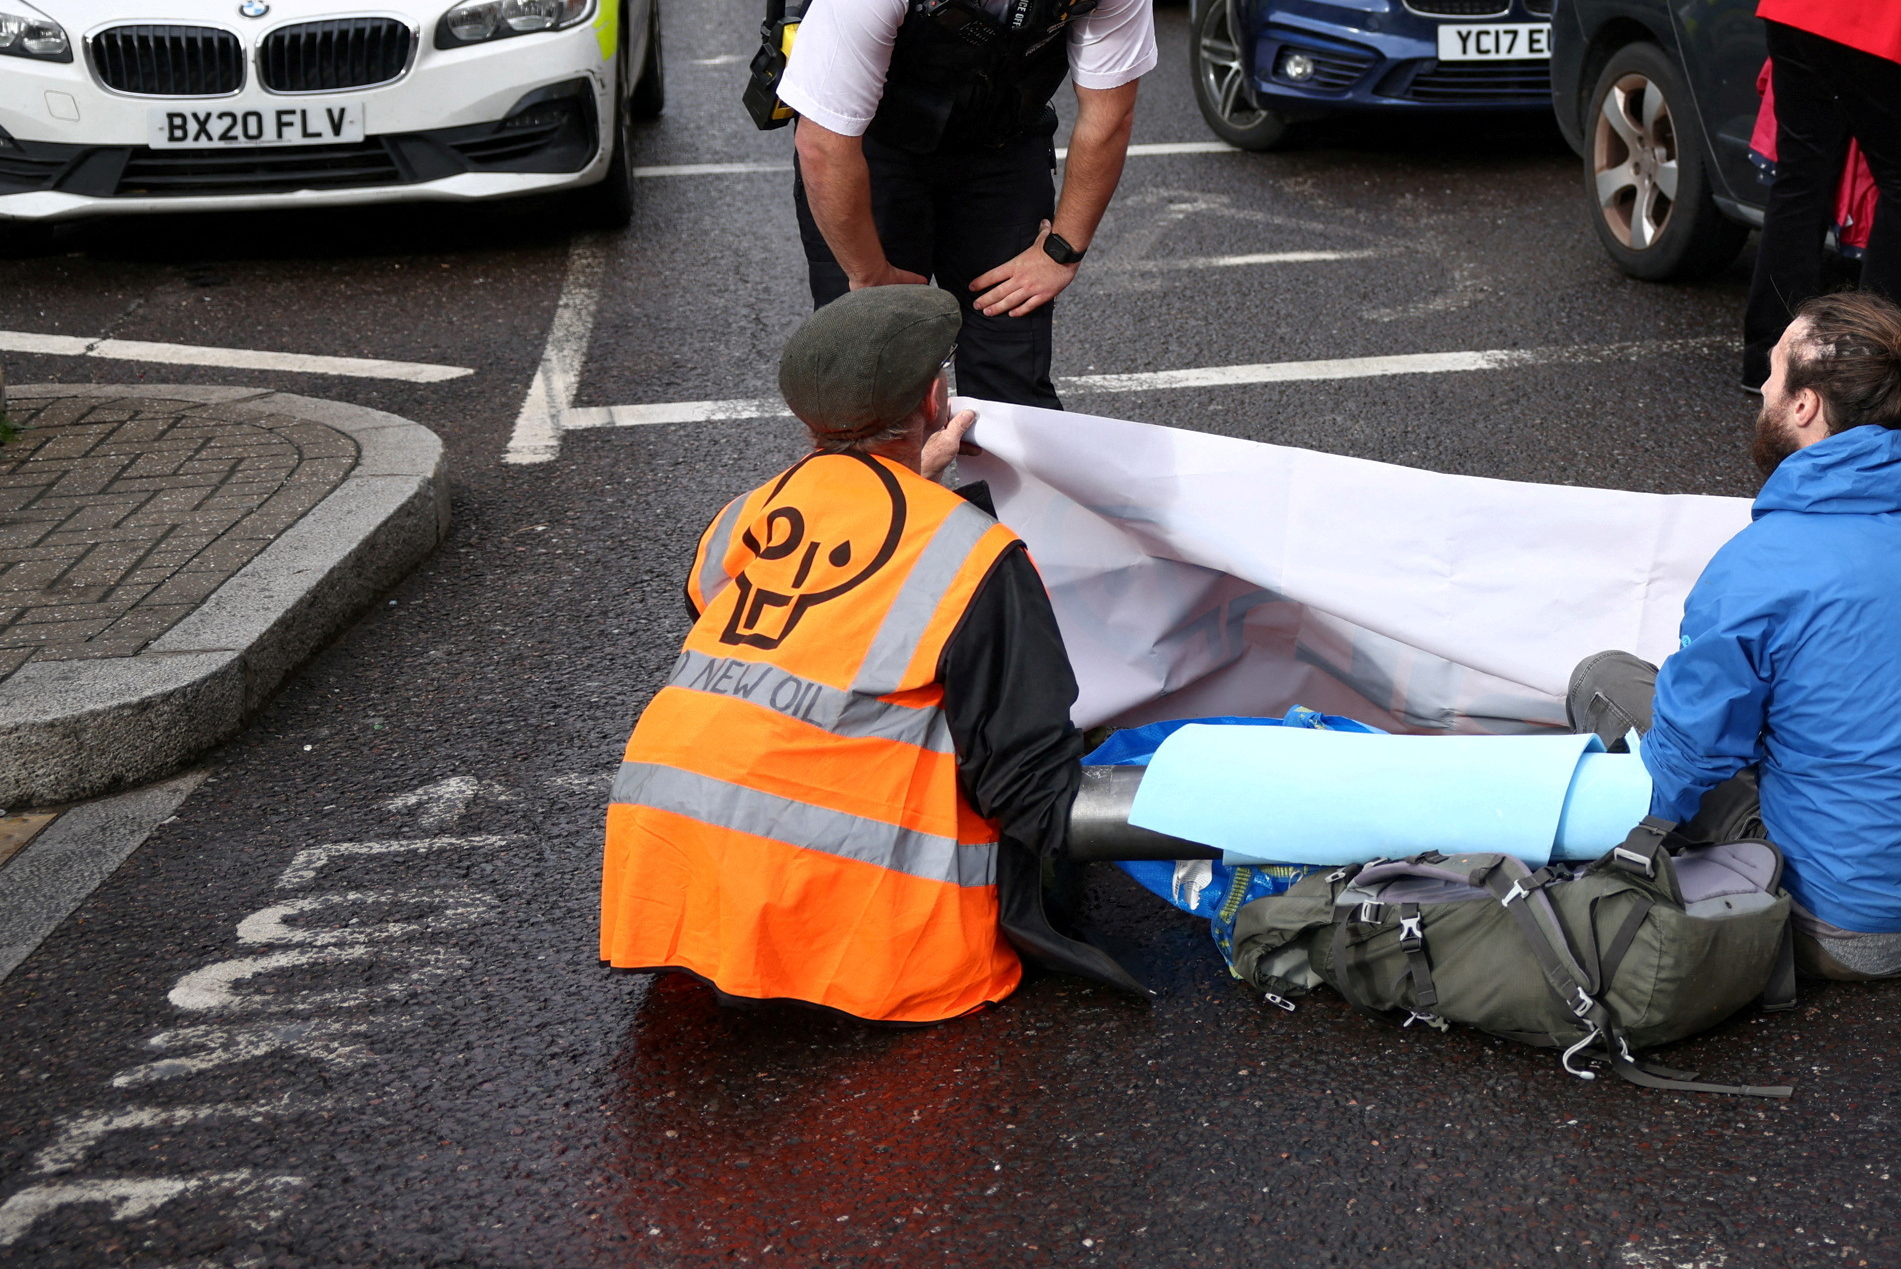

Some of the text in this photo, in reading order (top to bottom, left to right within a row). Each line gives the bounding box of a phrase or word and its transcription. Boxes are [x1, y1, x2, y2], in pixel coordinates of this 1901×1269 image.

[1456, 29, 1519, 55] YC17
[166, 107, 346, 143] BX20 FLV
[688, 657, 774, 700] NEW
[769, 675, 824, 728] OIL
